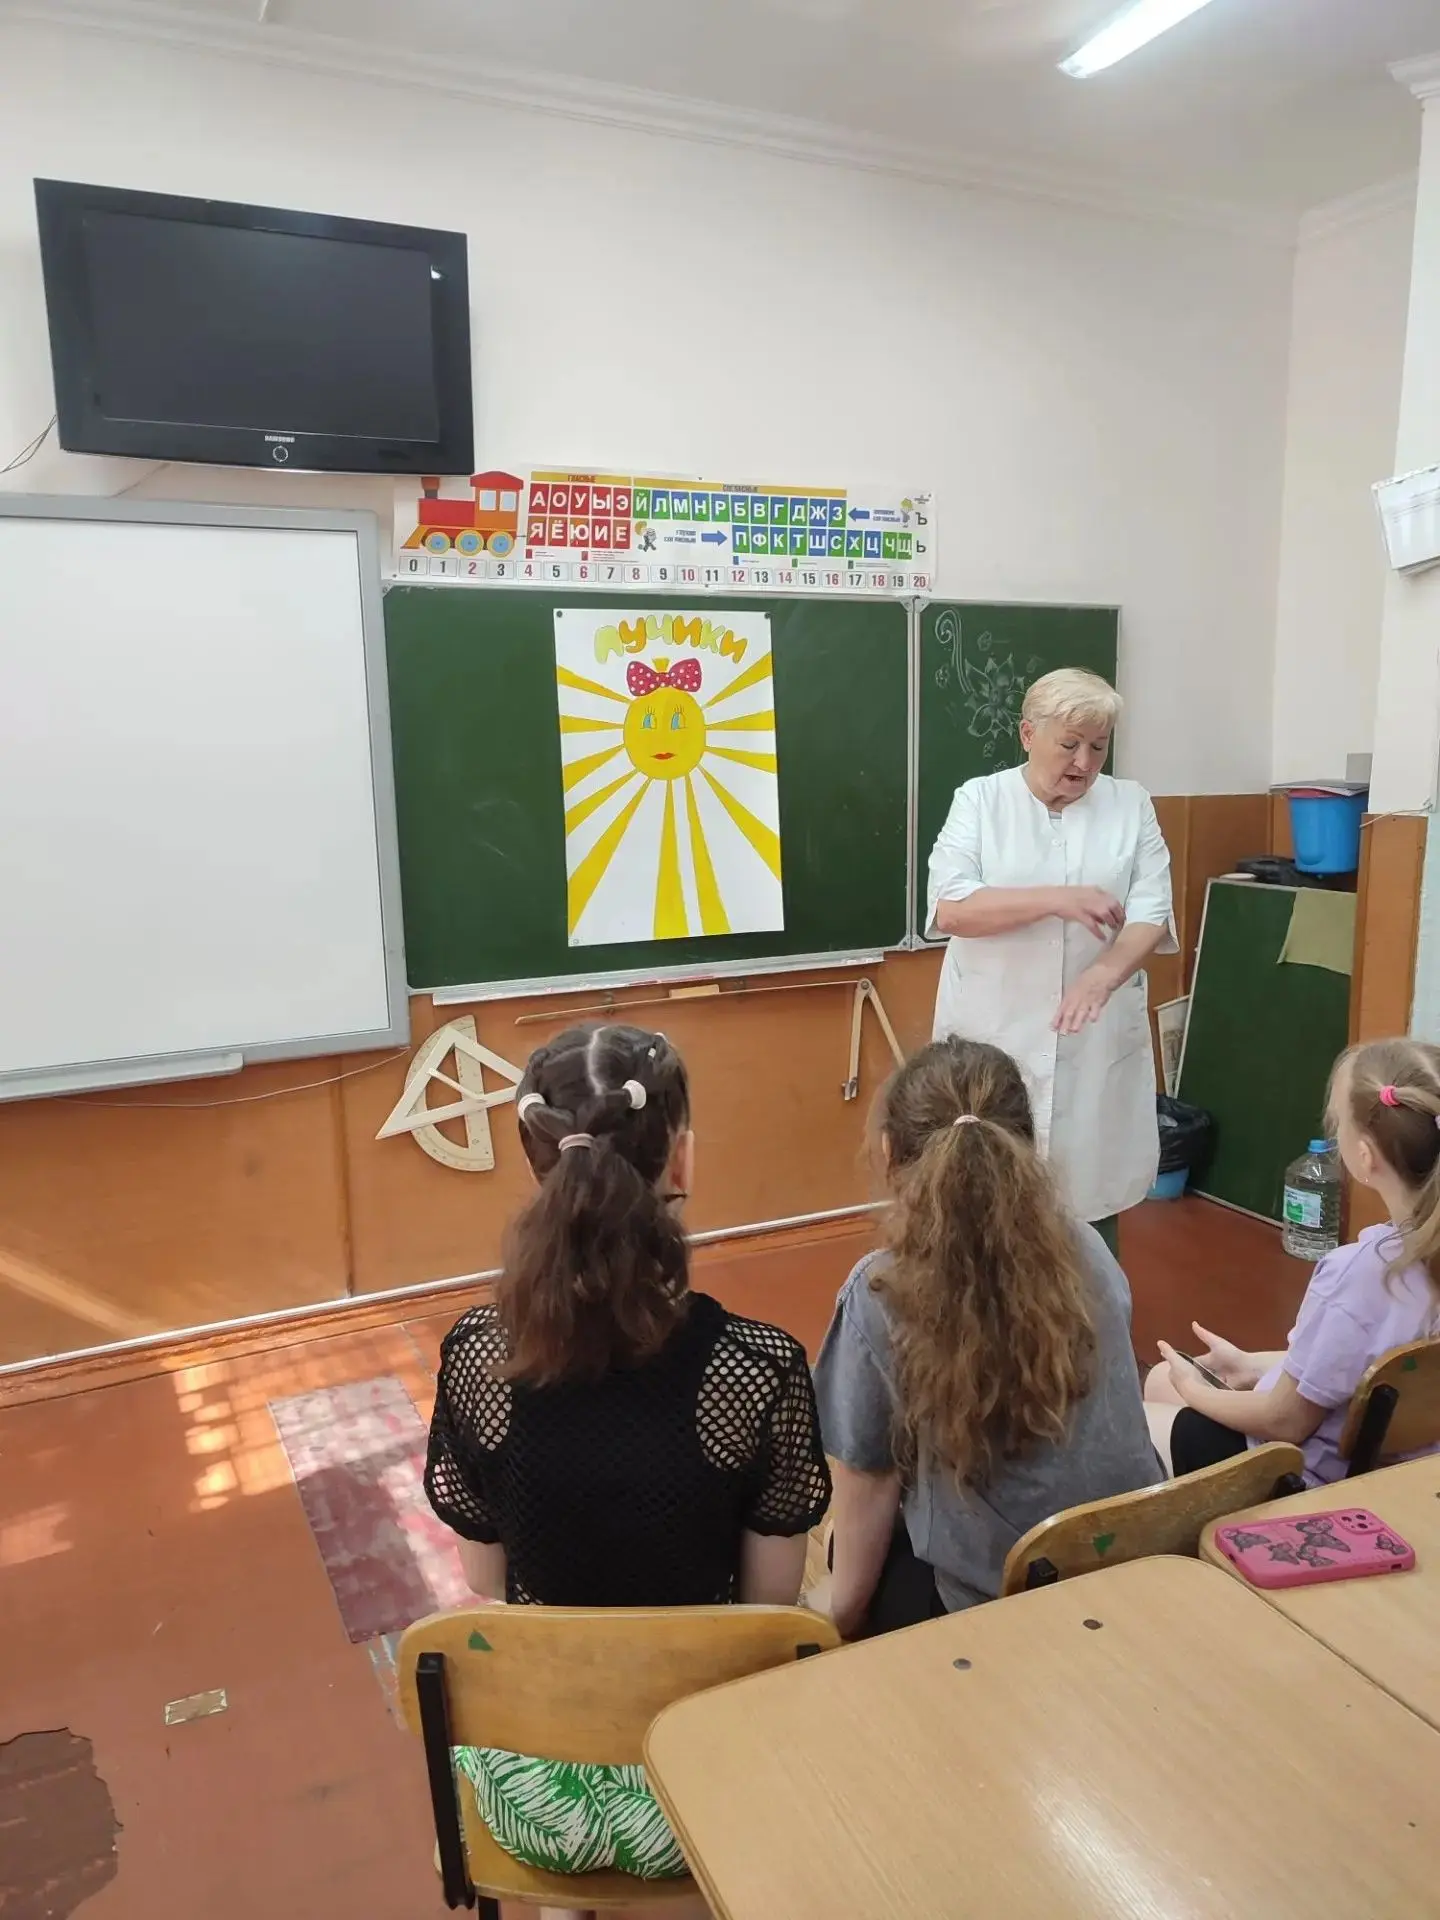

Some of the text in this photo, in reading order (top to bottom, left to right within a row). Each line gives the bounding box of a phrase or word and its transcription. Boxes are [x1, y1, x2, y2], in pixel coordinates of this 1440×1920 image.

[532, 491, 843, 522] А О У Ы Э Й Л М Н Р Б В Г Д Ж З
[530, 520, 627, 541] Я Ё Ю И Е
[735, 532, 912, 555] П Ф К Т Ш С Х Ц Ч Щ
[410, 559, 926, 587] 0 1 2 3 4 5 6 7 8 9 10 11 12 13 14 15 16 17 18 19 20
